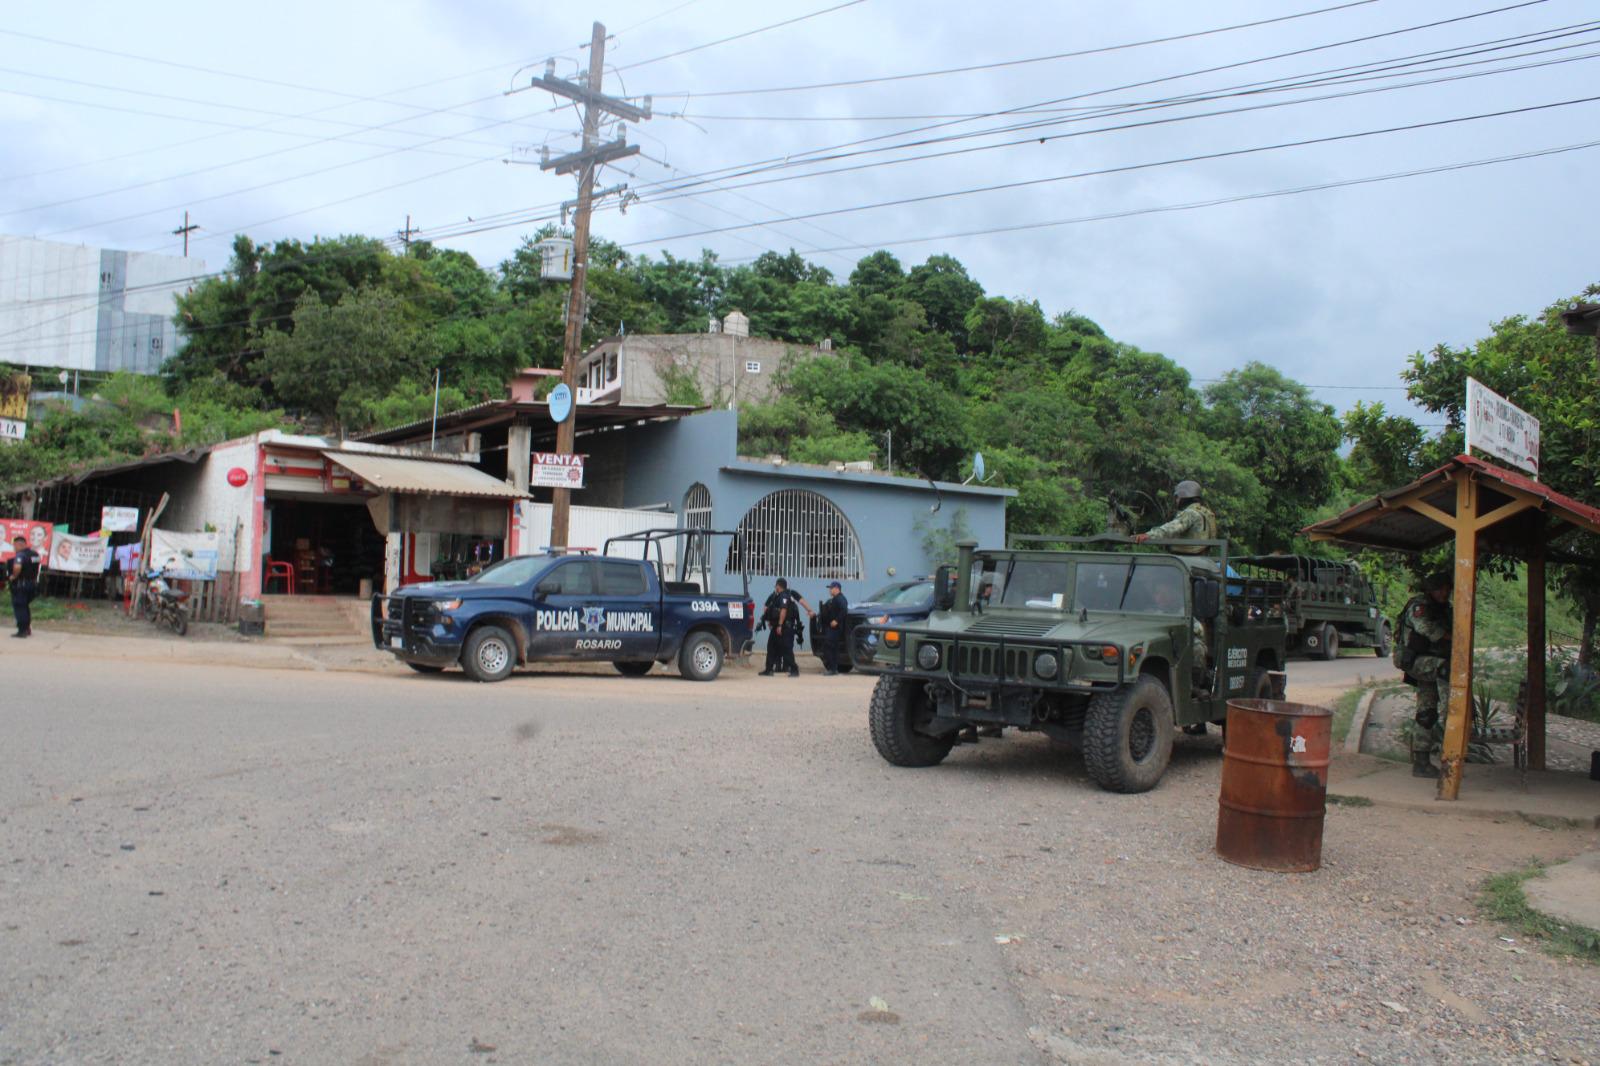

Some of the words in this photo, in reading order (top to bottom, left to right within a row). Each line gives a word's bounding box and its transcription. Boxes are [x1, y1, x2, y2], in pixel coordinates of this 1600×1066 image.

[535, 453, 582, 466] VENTA
[691, 601, 721, 612] 039A
[536, 607, 579, 631] POLICÍA
[606, 611, 654, 632] MUNICIPAL
[575, 639, 622, 649] ROSARIO
